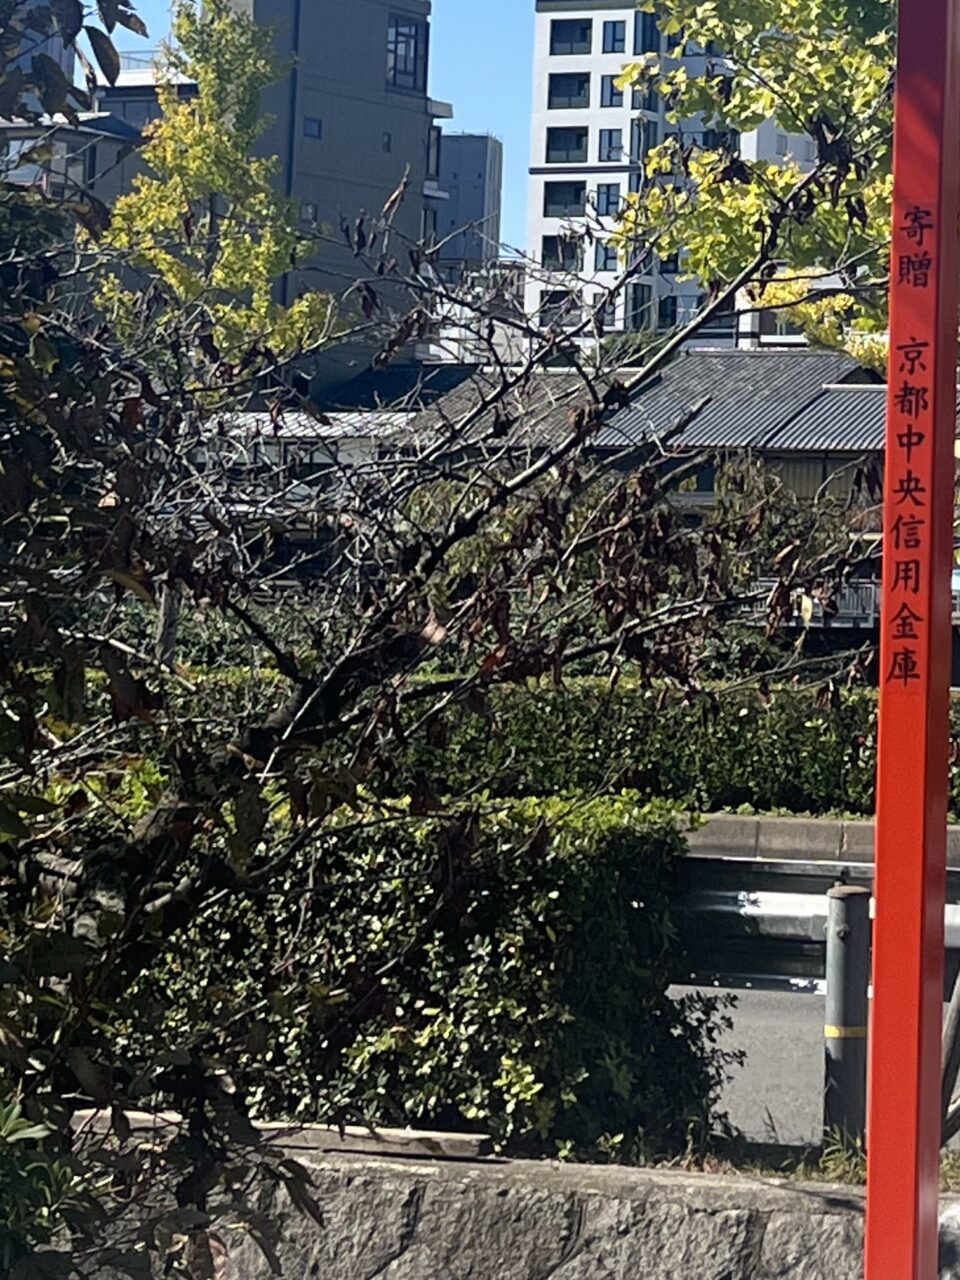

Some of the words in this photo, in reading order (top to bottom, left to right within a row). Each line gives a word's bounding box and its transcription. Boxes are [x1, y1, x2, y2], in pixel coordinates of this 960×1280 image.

[896, 205, 934, 289] 寄贈
[886, 336, 929, 688] 京都中央信用金庫
